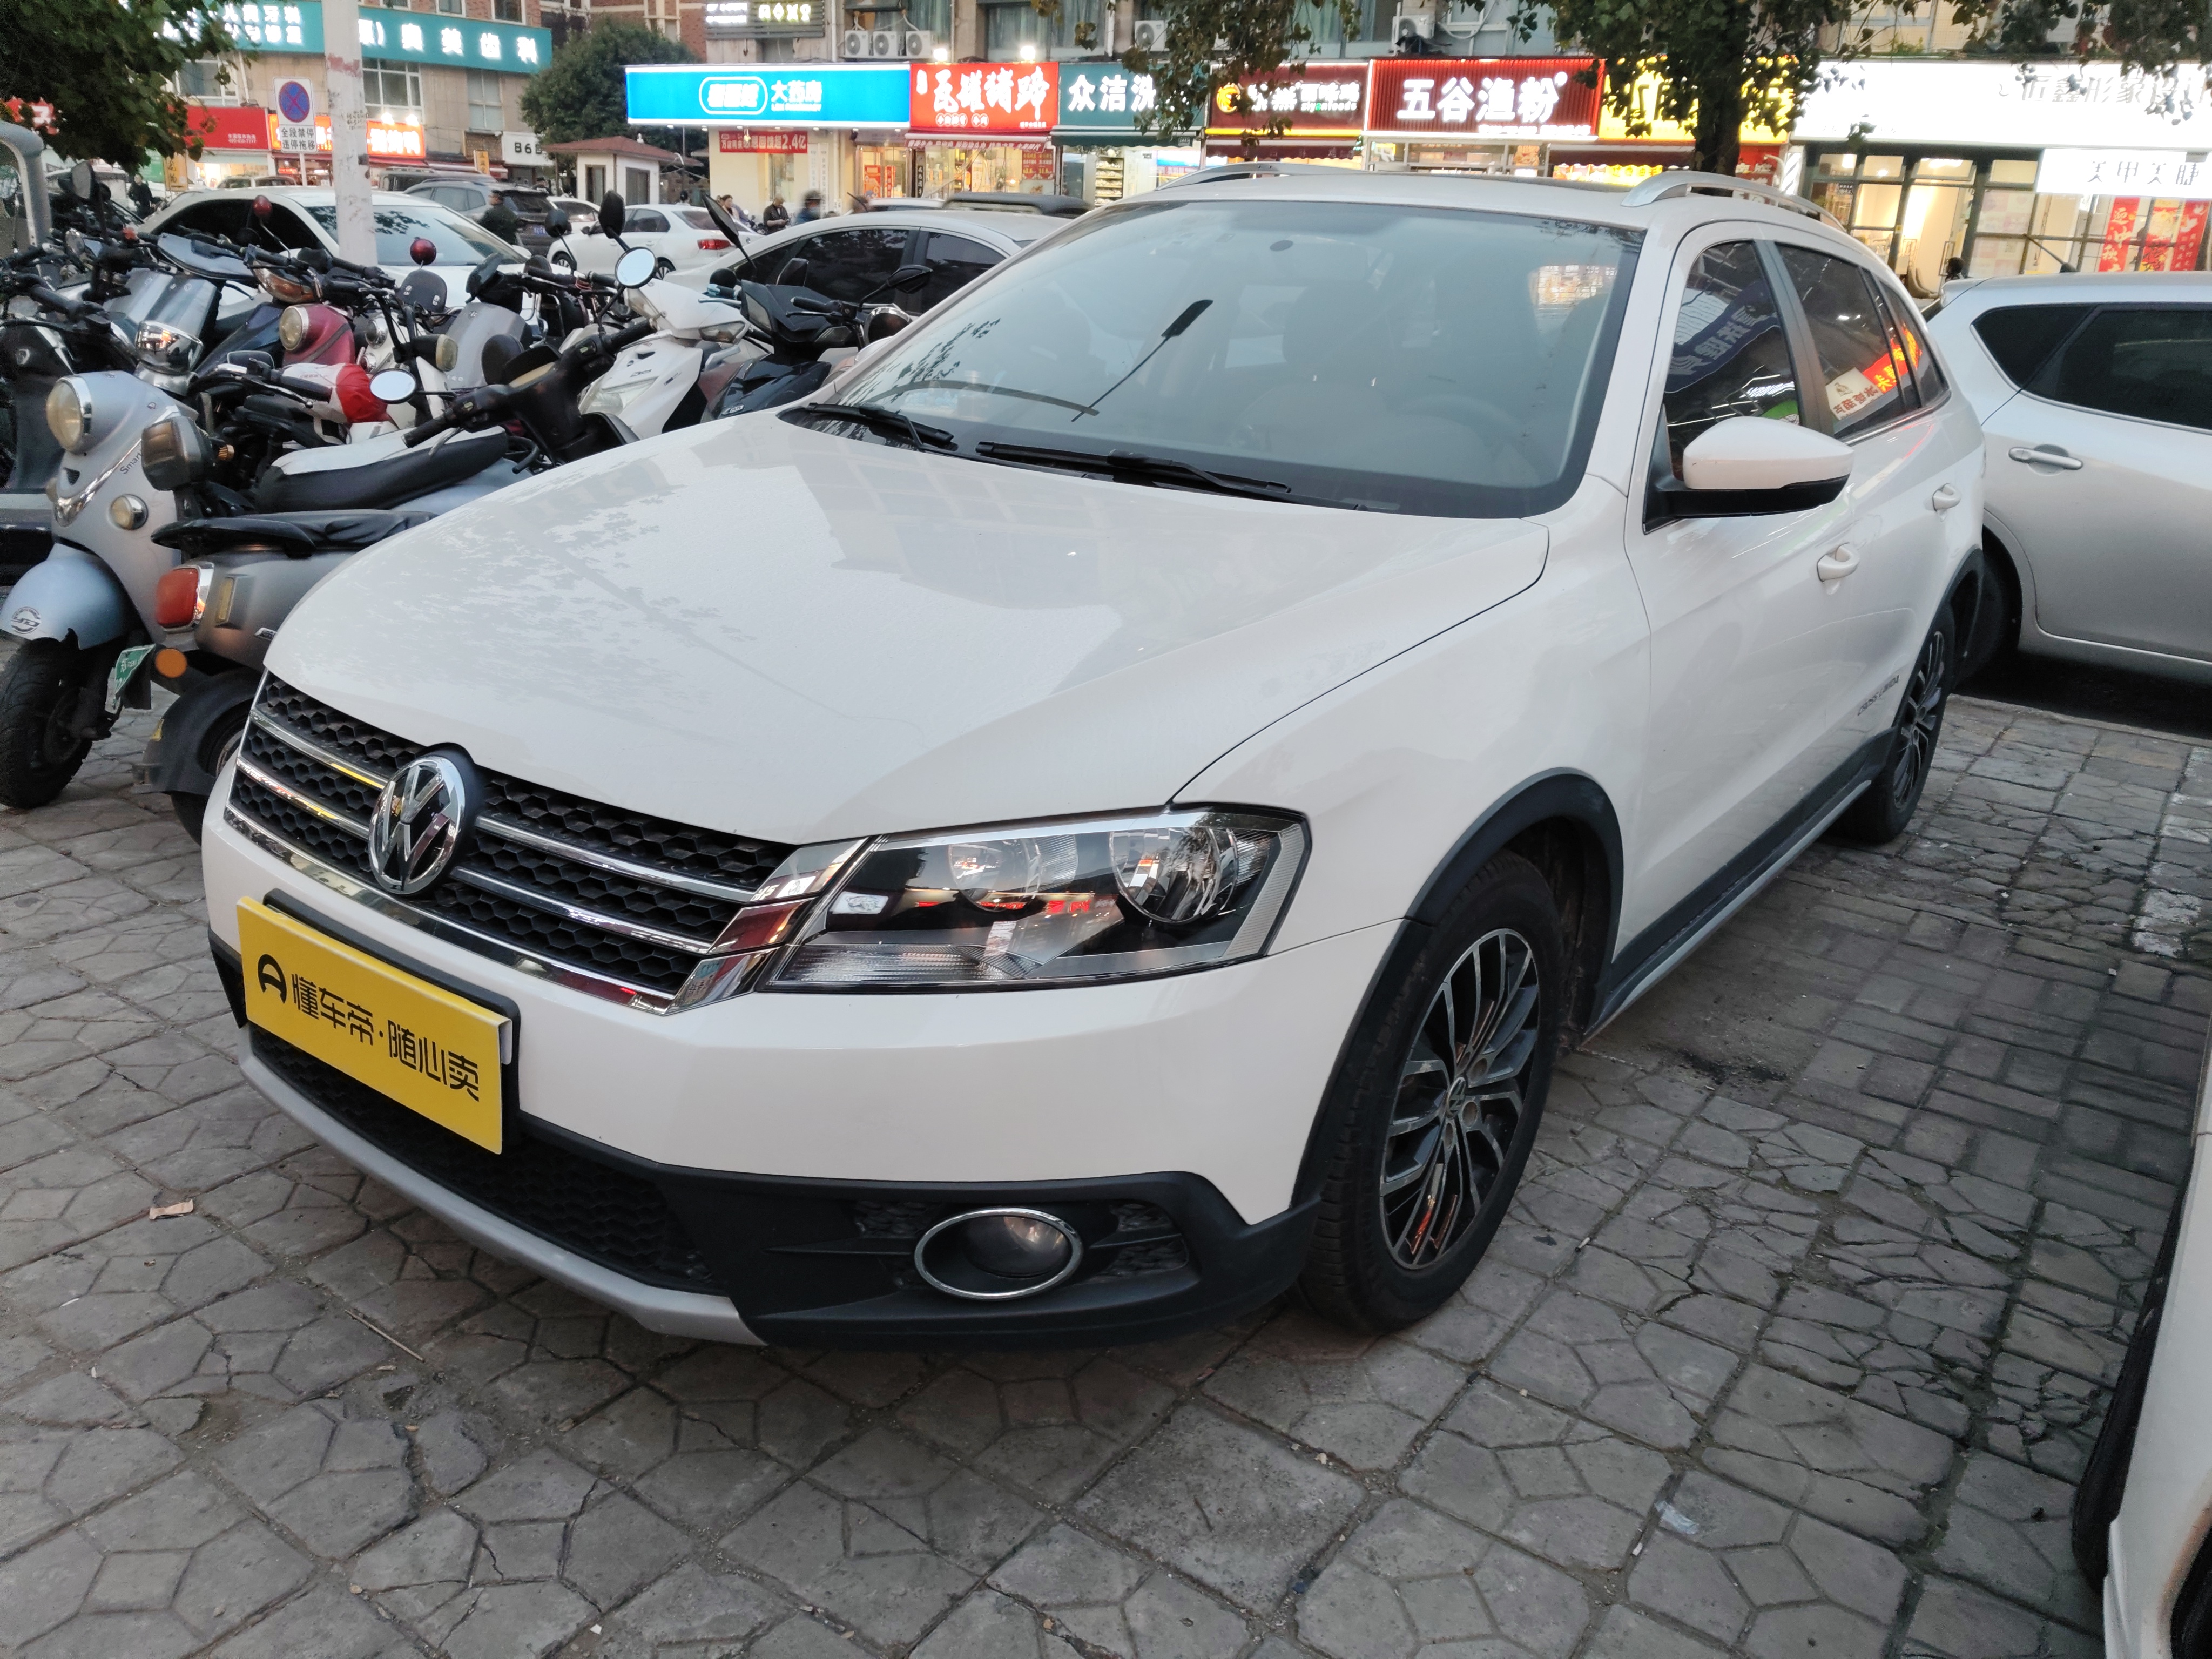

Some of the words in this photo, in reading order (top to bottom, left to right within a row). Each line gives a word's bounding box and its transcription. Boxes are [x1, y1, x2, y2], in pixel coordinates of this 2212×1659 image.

[772, 80, 821, 102] 大药房
[1068, 74, 1190, 112] 众洁洗
[1397, 77, 1560, 123] 五谷渔粉
[281, 127, 315, 138] 全段禁停
[282, 139, 315, 150] 违停拖移
[291, 973, 480, 1103] 懂车帝·随心卖
